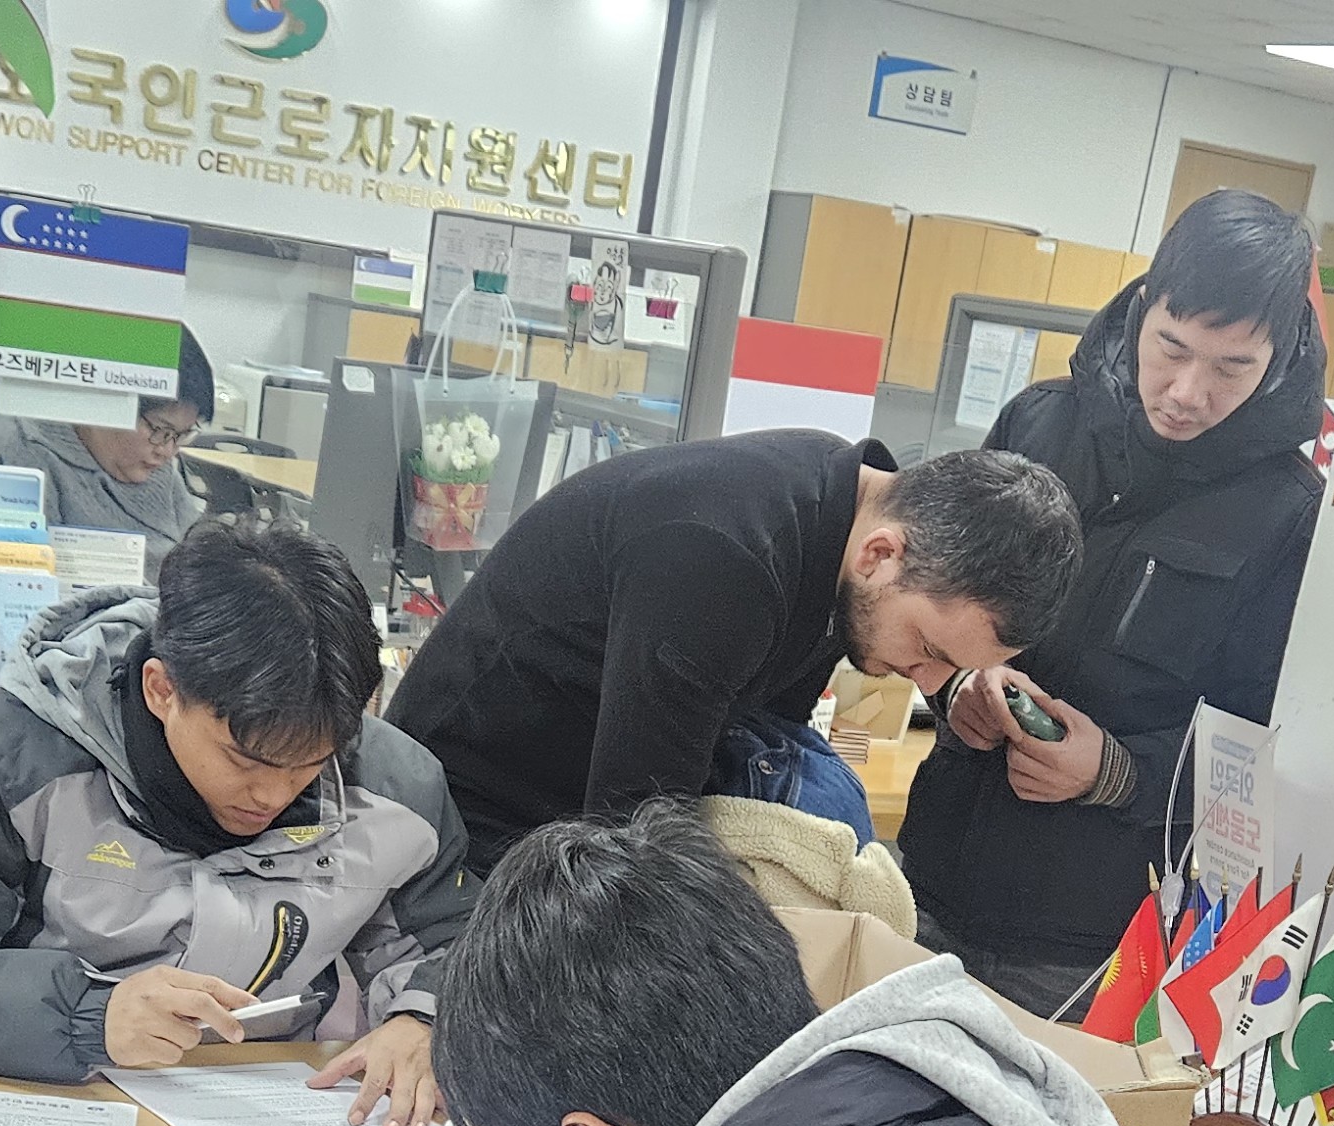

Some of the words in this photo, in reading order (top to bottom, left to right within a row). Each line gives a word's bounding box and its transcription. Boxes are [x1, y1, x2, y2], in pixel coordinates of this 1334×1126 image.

[68, 126, 188, 166] SUPPORT
[197, 148, 296, 187] CENTER
[304, 167, 353, 196] FOR
[361, 179, 463, 210] FOREIGN
[104, 369, 169, 391] Uzbekistan
